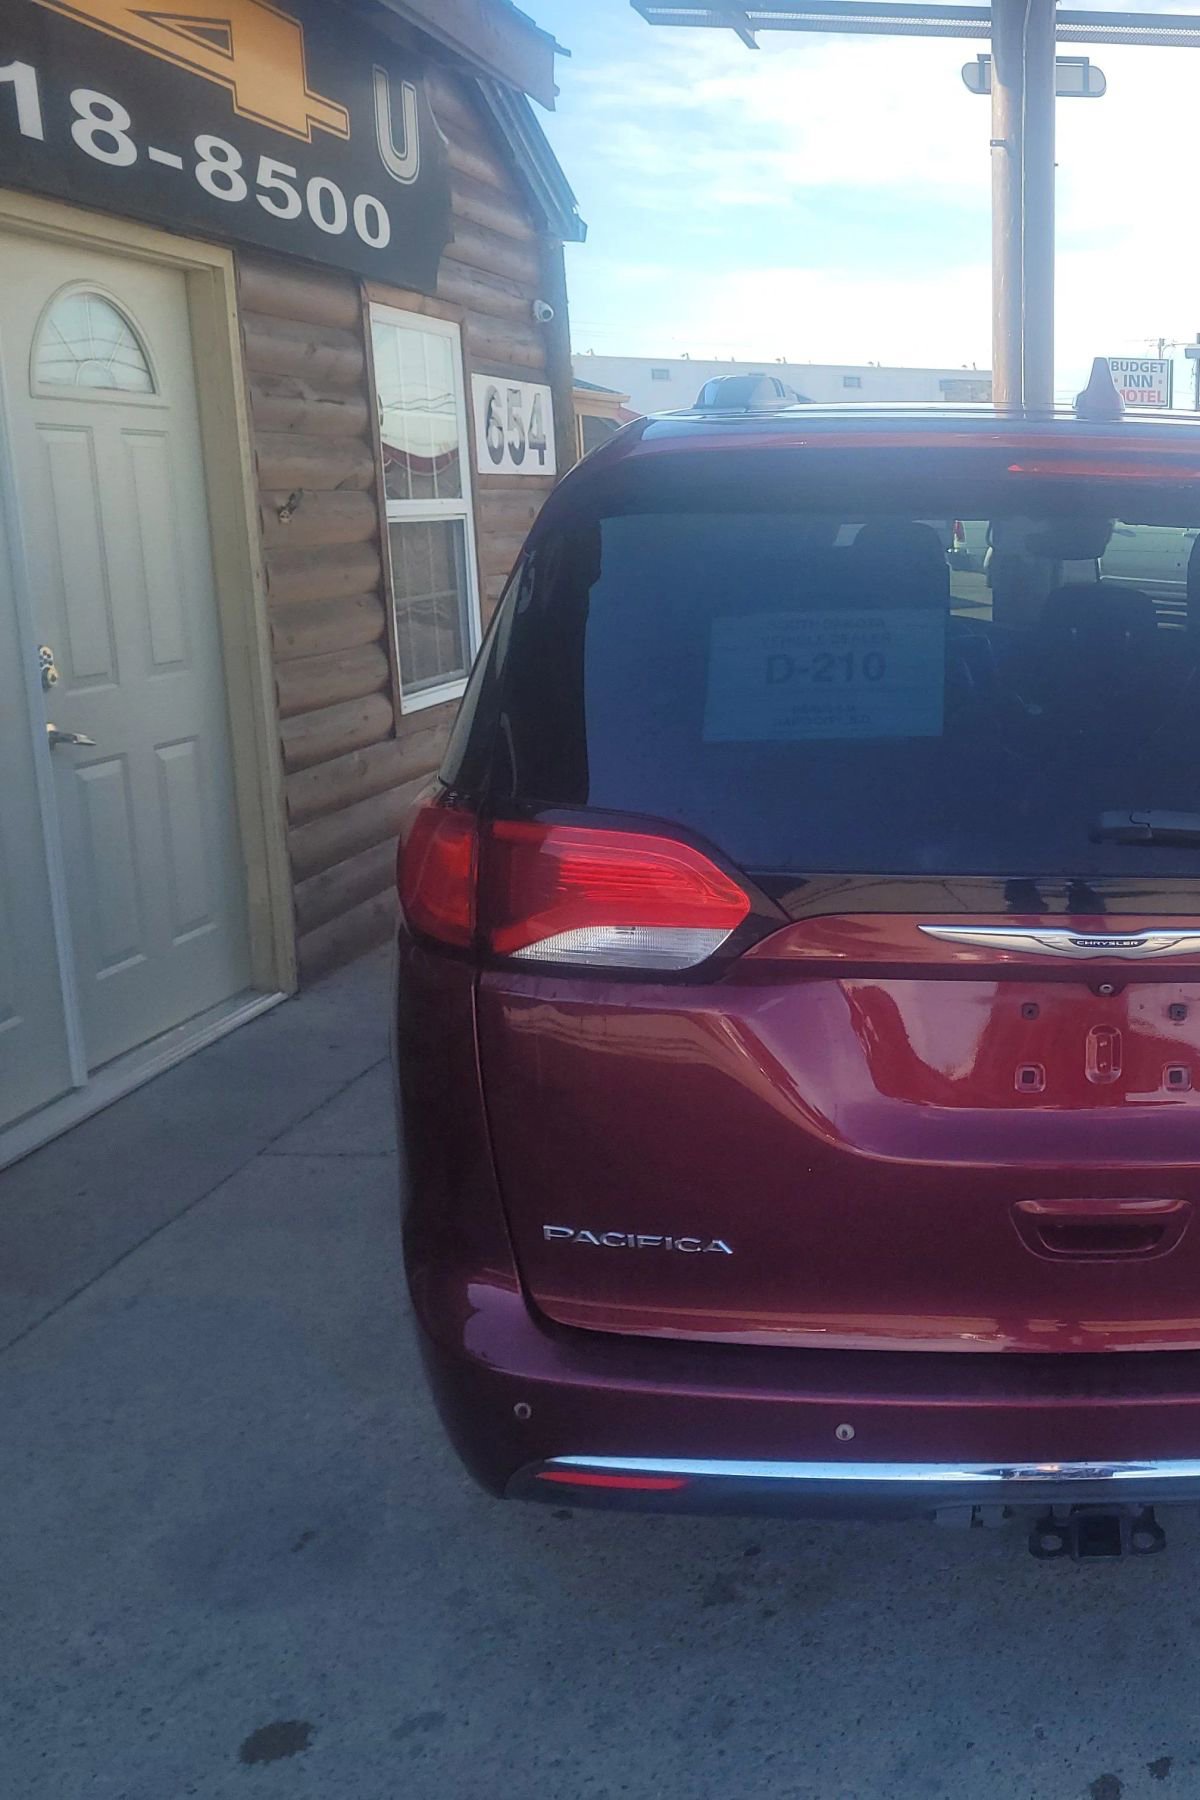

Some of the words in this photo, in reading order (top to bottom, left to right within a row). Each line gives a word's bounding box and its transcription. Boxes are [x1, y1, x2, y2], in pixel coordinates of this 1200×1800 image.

[372, 63, 421, 185] U
[1110, 360, 1166, 373] BUDGET
[1123, 374, 1153, 388] INN
[484, 384, 547, 467] 654
[765, 651, 888, 685] D-210
[542, 1224, 734, 1255] PACIFICA
